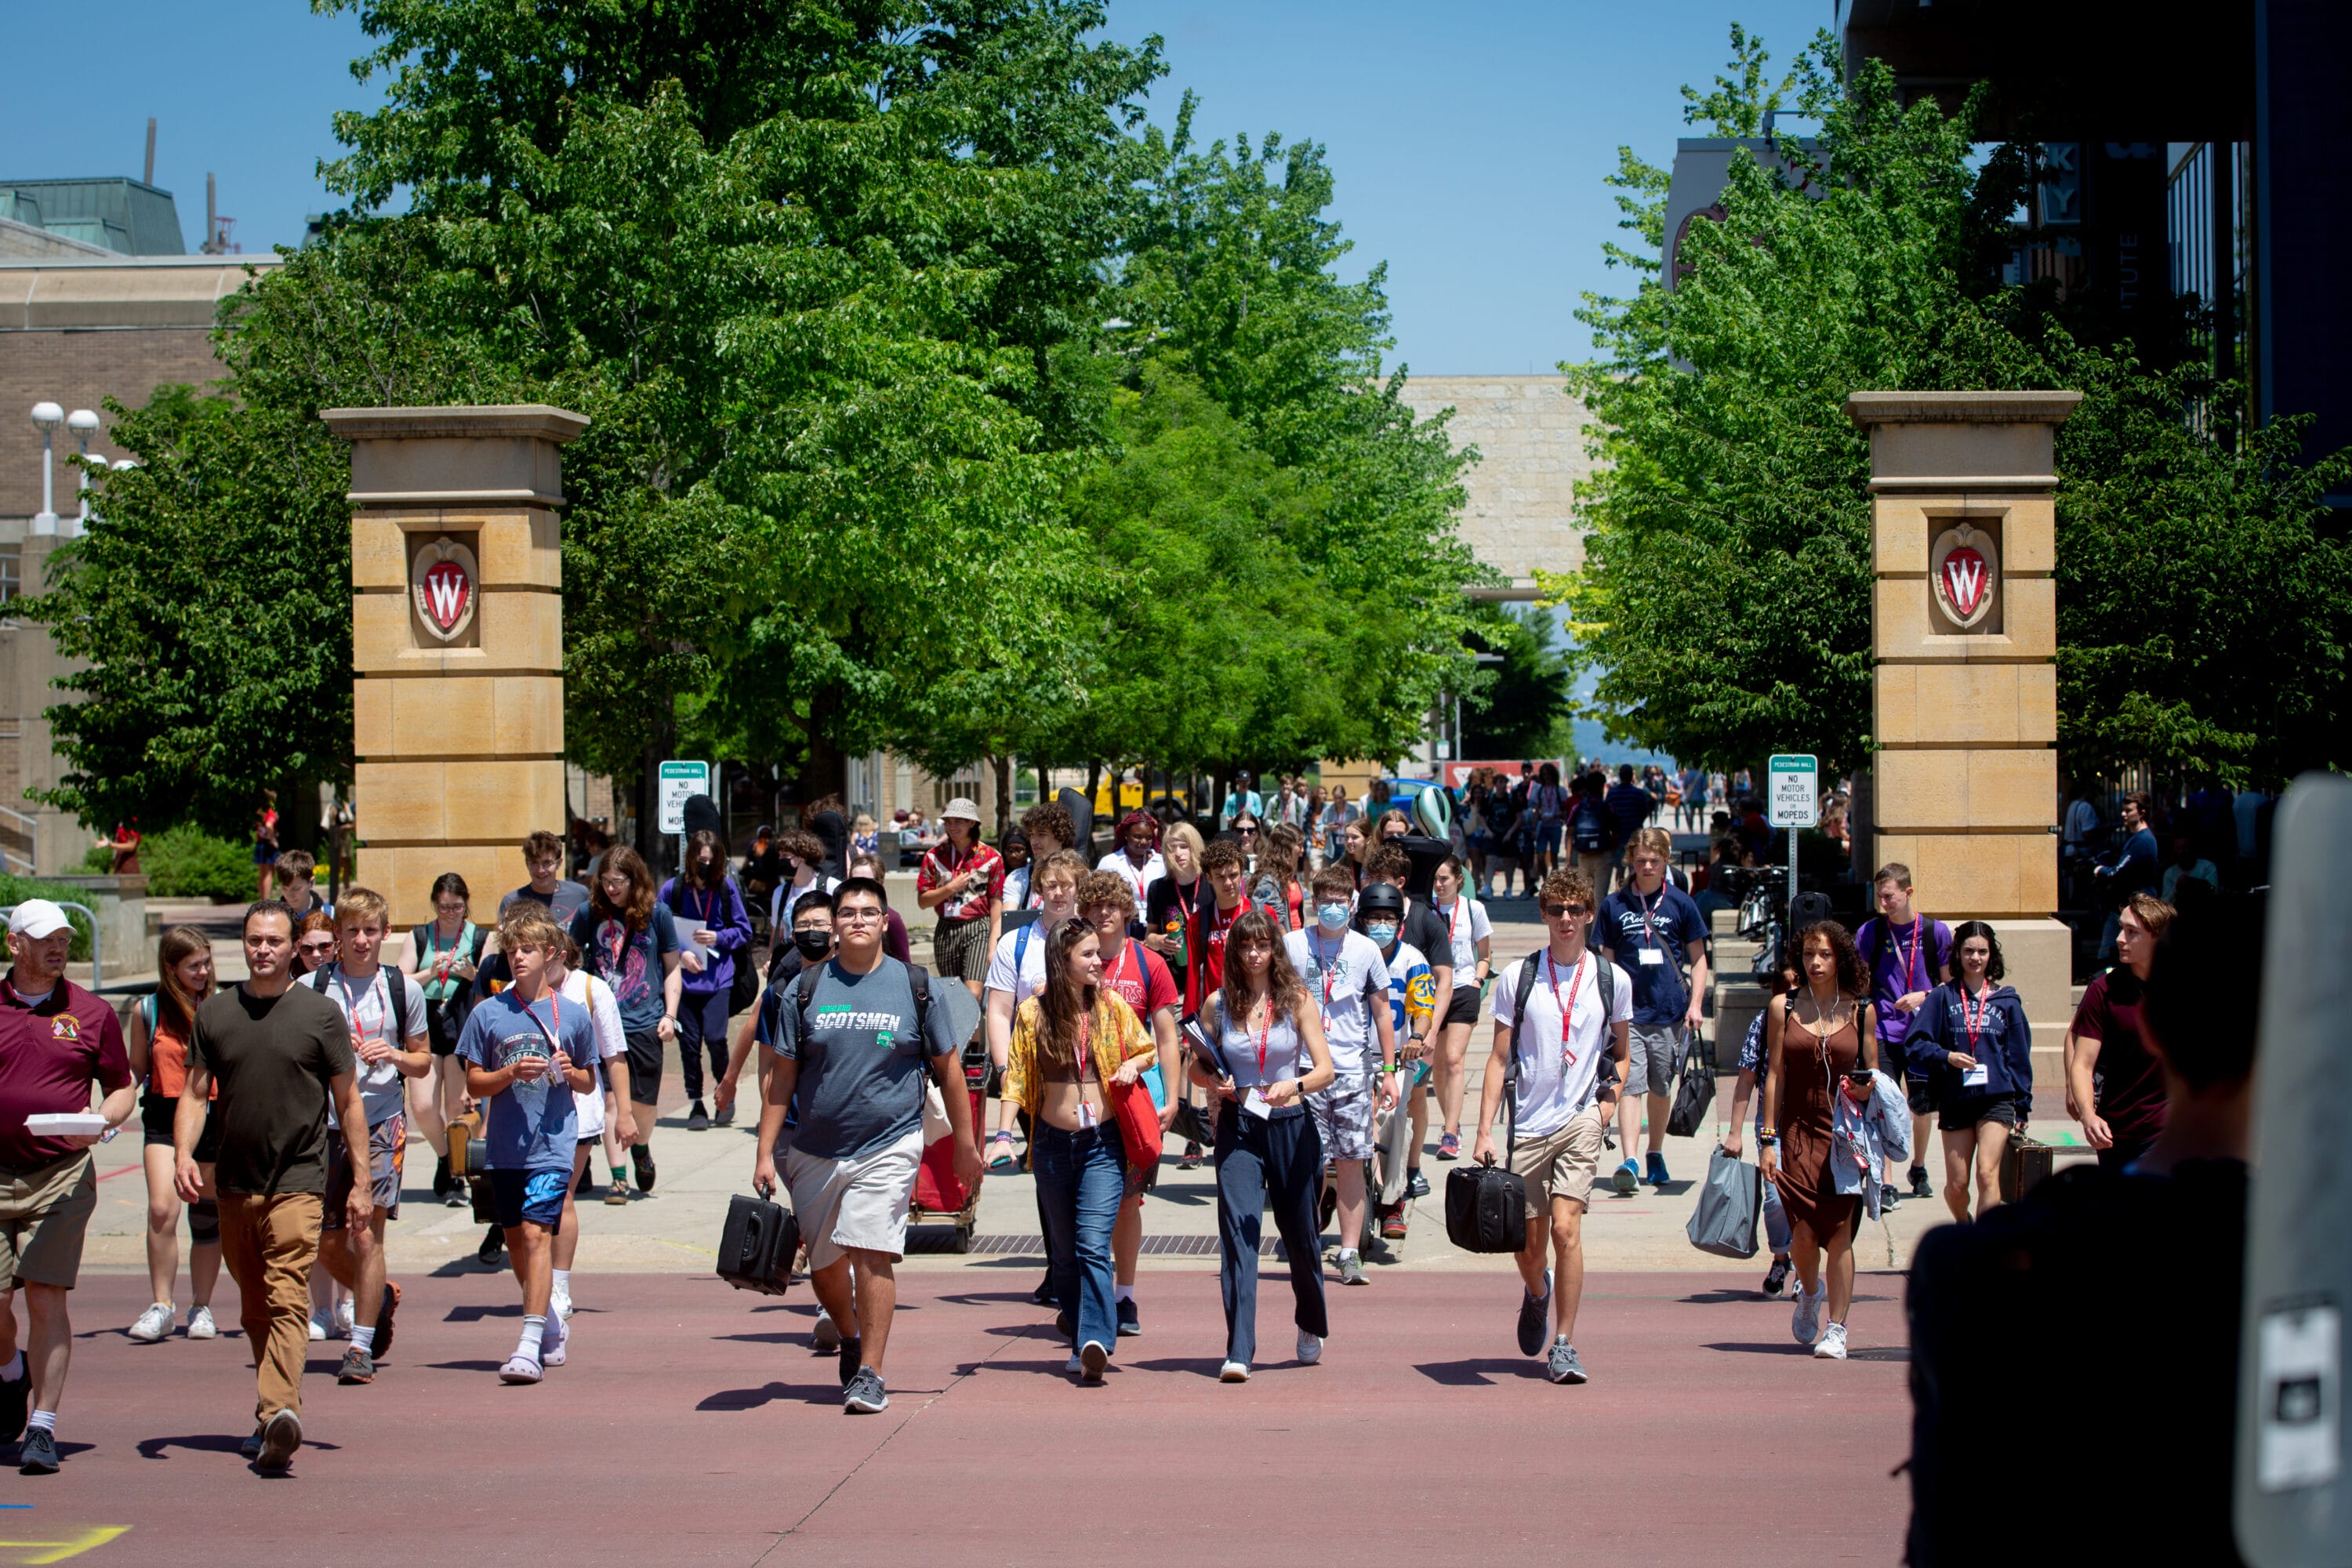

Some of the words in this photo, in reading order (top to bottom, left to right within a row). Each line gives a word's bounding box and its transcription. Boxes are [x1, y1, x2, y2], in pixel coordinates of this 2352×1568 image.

[1946, 558, 1983, 608] W
[428, 572, 463, 621] W
[1788, 775, 1798, 783] NO
[1777, 811, 1809, 819] MOPEDS
[818, 1004, 852, 1013] HIGHLAND
[814, 1011, 901, 1032] SCOTSMEN
